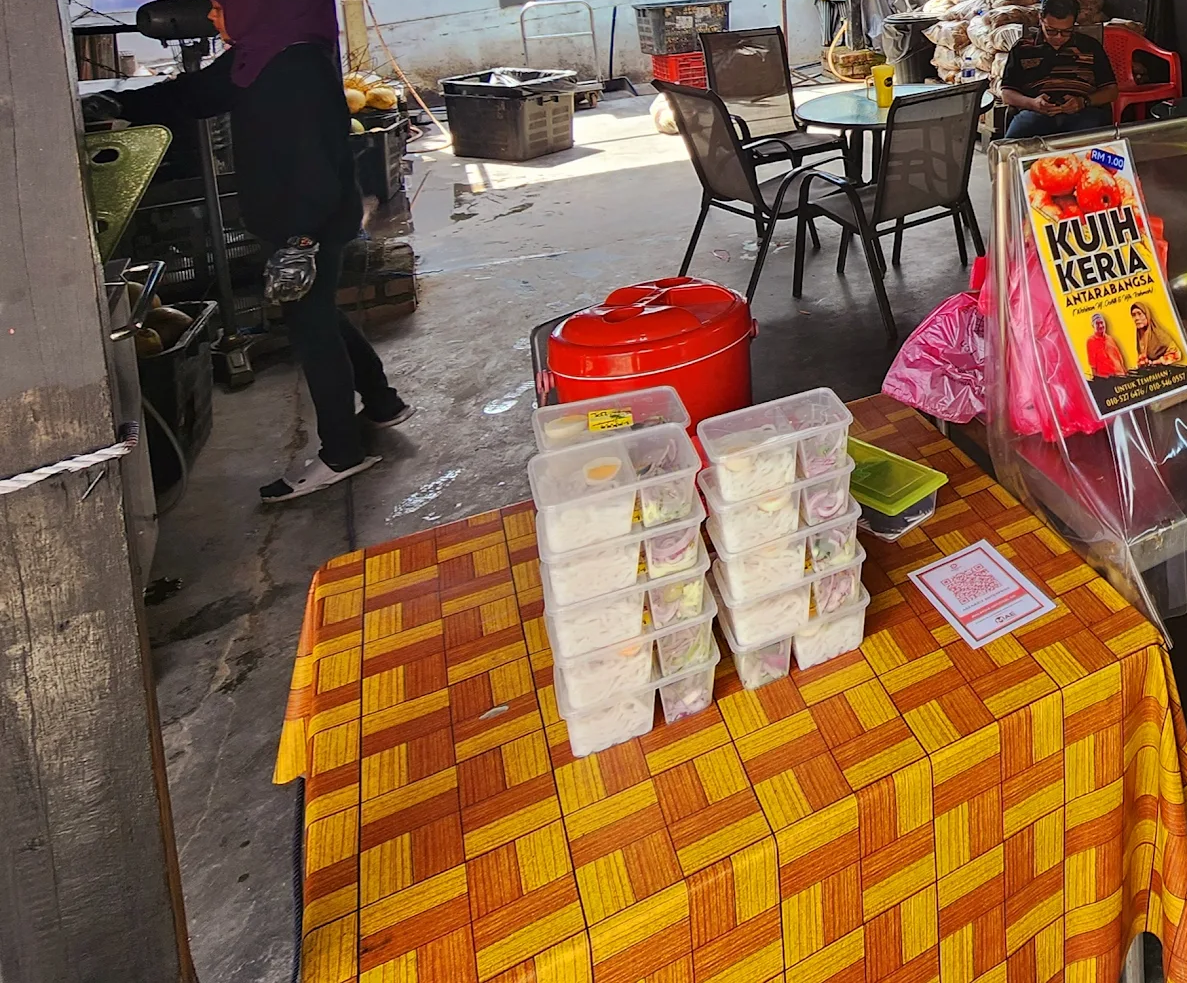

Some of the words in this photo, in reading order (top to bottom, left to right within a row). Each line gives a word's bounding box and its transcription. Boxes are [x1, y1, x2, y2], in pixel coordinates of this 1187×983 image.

[1091, 150, 1105, 162] RM
[1107, 155, 1124, 168] 1.00
[1044, 205, 1140, 261] KUIH
[1054, 245, 1149, 293] KERIA
[1066, 274, 1154, 307] ANTARABANGSA
